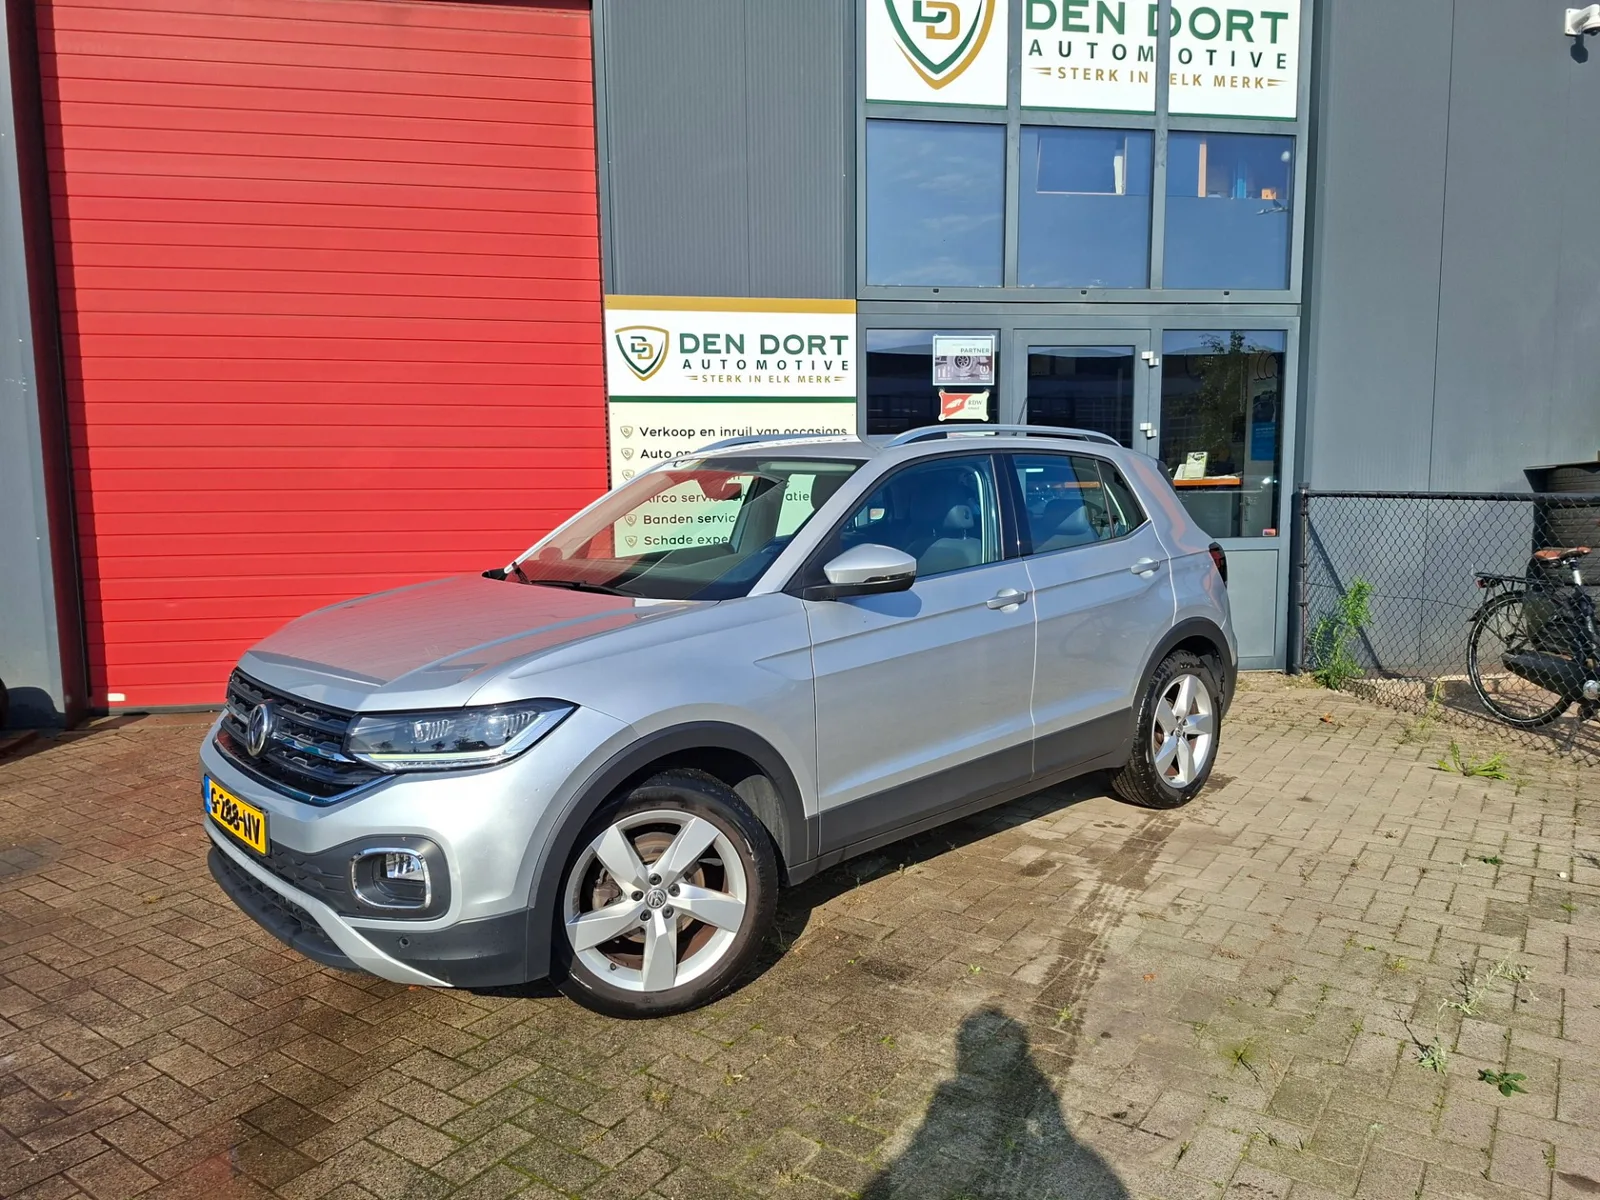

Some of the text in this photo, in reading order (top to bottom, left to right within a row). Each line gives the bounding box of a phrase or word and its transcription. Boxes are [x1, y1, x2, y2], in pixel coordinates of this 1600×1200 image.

[1025, 0, 1289, 44] DEN DORT
[1028, 38, 1287, 70] AUTOMOTIVE
[1057, 66, 1264, 89] STERK IN ELK MERK
[679, 332, 849, 356] DEN DORT
[682, 358, 849, 371] AUTOMOTIVE
[702, 374, 831, 384] STERK IN ELK MERK
[639, 426, 696, 440] Verkoop
[699, 428, 716, 437] en
[720, 425, 752, 438] inruil
[756, 428, 780, 436] van
[640, 448, 672, 459] Auto
[643, 512, 736, 525] Banden servic
[643, 534, 729, 546] Schade expe
